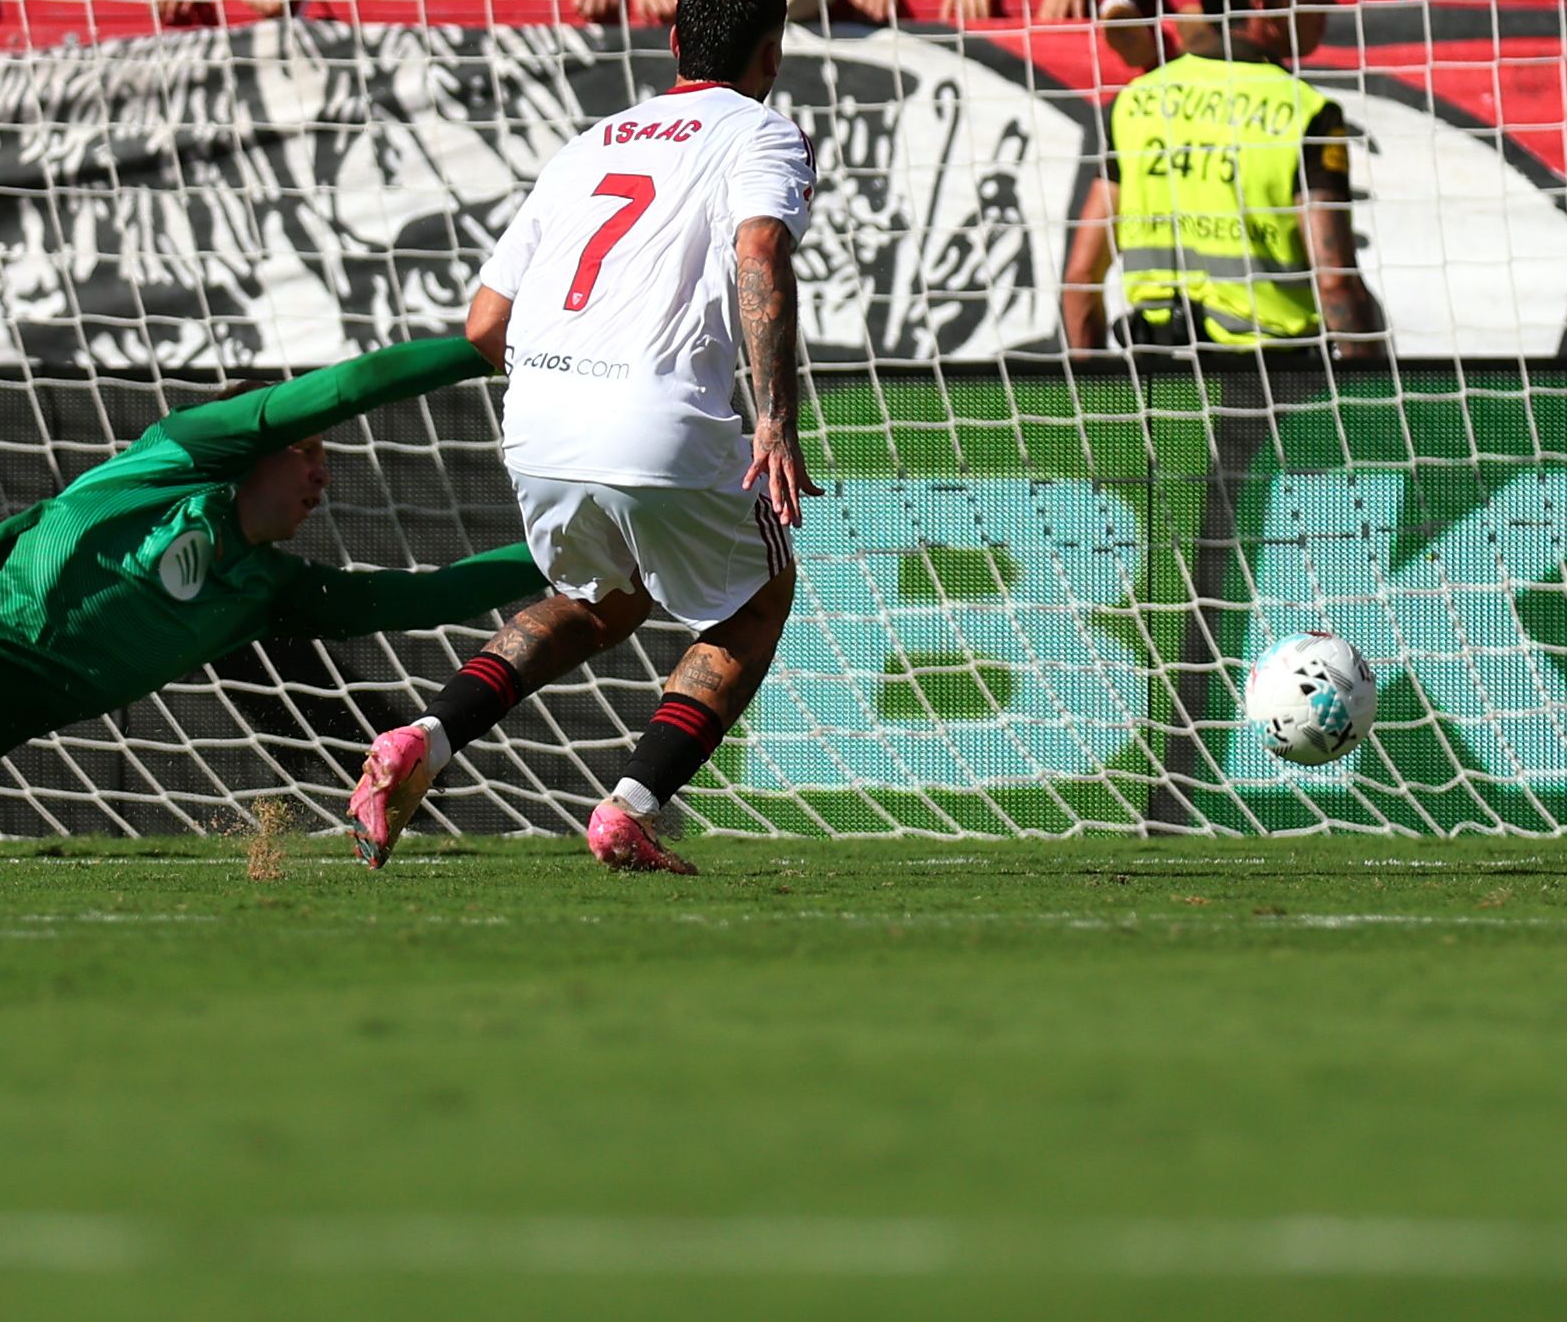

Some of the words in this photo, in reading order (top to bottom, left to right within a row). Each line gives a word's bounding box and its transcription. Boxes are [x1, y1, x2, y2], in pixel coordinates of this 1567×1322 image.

[602, 118, 703, 147] ISAAC
[1146, 137, 1240, 183] 2475
[562, 172, 657, 312] 7
